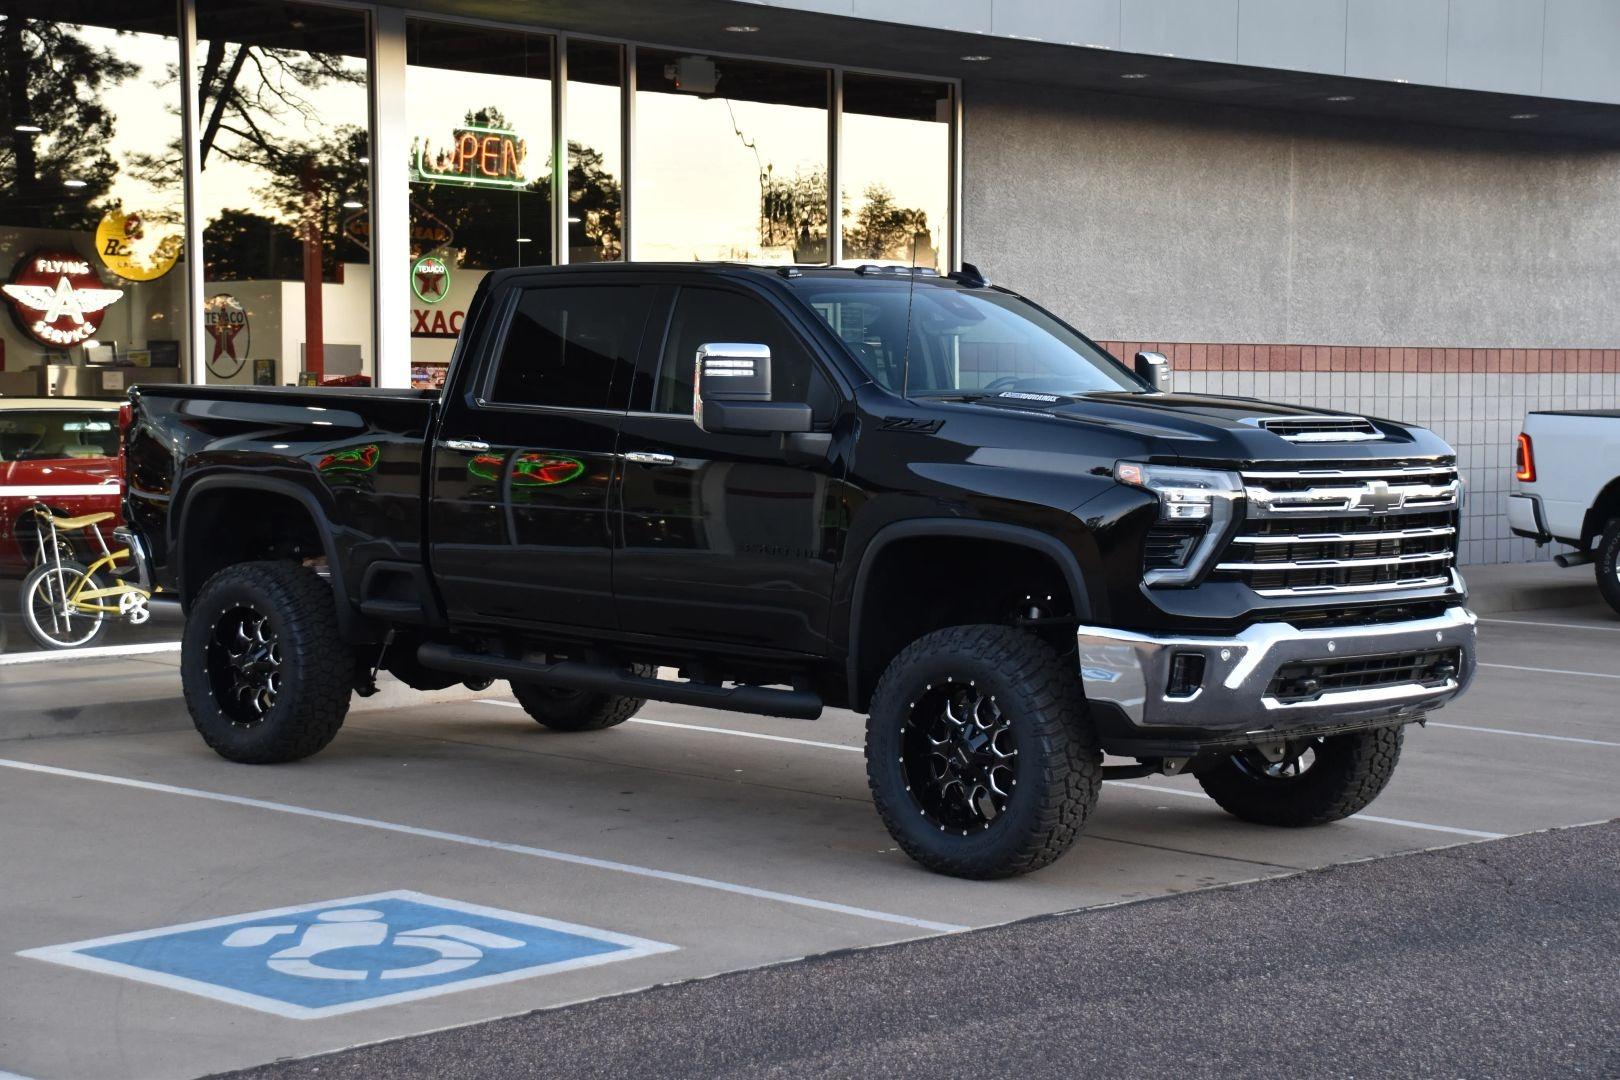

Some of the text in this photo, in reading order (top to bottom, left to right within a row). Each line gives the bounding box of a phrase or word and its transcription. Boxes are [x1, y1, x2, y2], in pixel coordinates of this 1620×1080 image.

[424, 133, 527, 180] OPEN
[37, 259, 90, 274] FLYING
[418, 265, 445, 274] TEXACO
[205, 311, 244, 324] TEXACO
[33, 320, 97, 344] SERVICE
